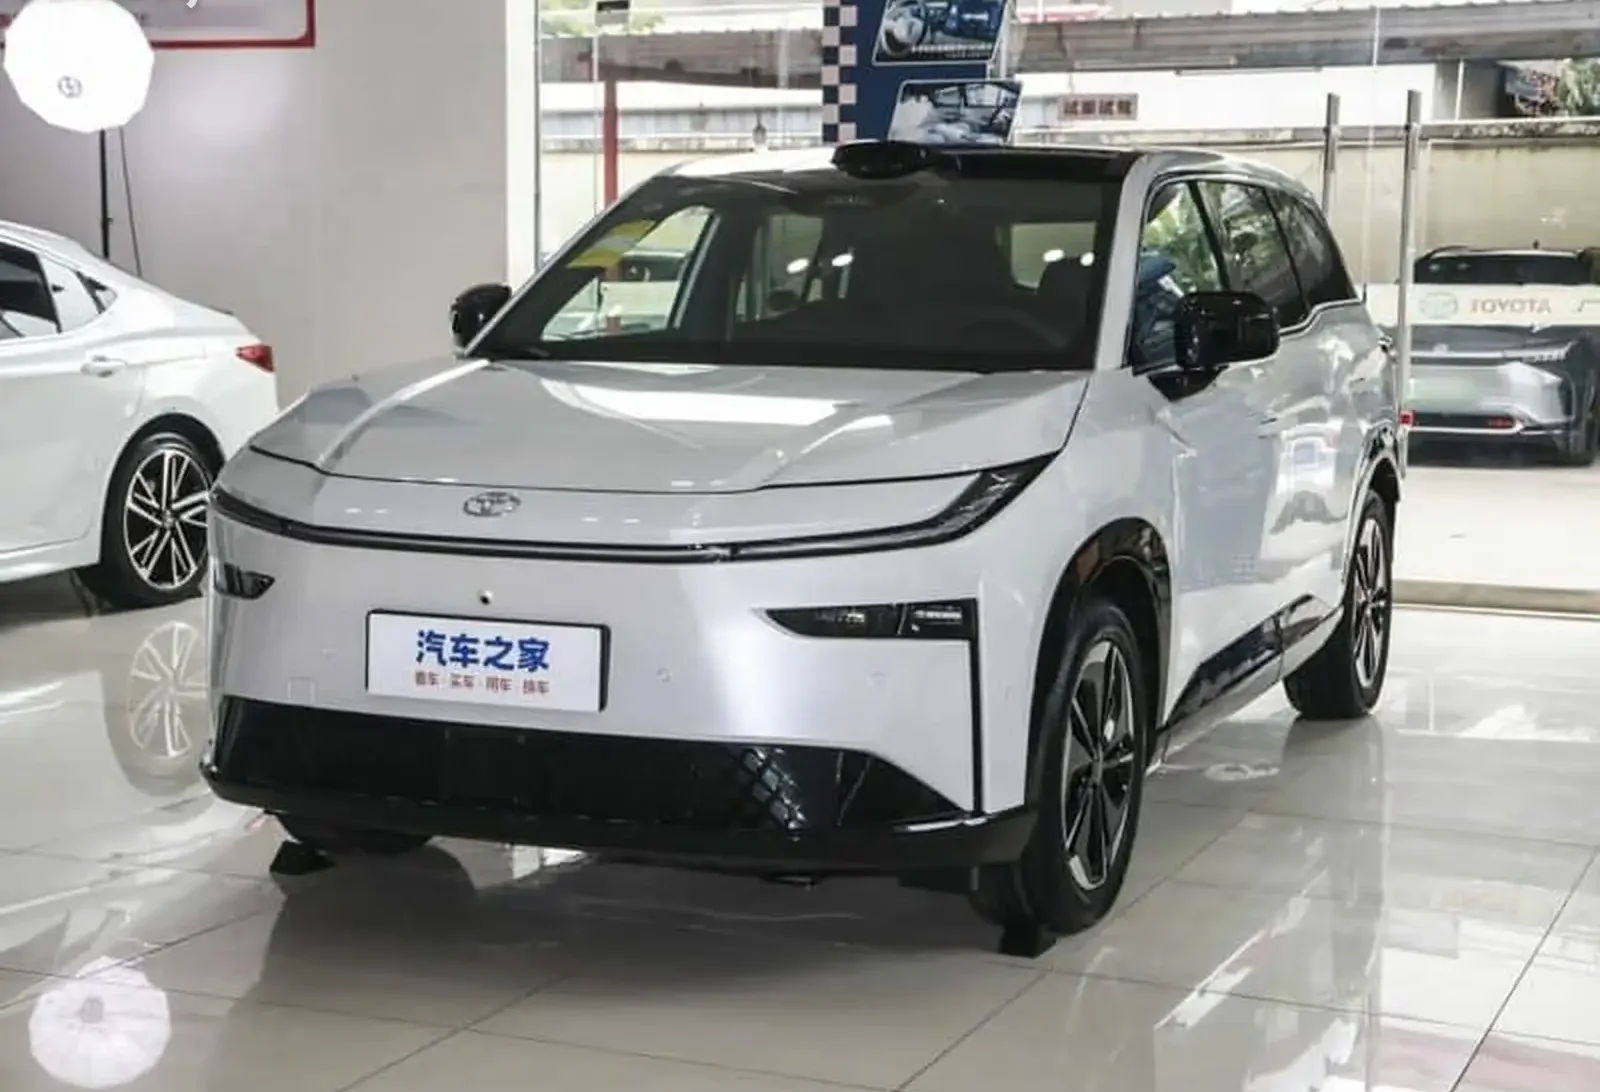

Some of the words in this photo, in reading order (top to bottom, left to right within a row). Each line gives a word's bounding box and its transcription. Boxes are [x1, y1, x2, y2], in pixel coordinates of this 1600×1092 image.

[1471, 298, 1552, 314] TOYOTA
[416, 630, 549, 671] 汽车之家
